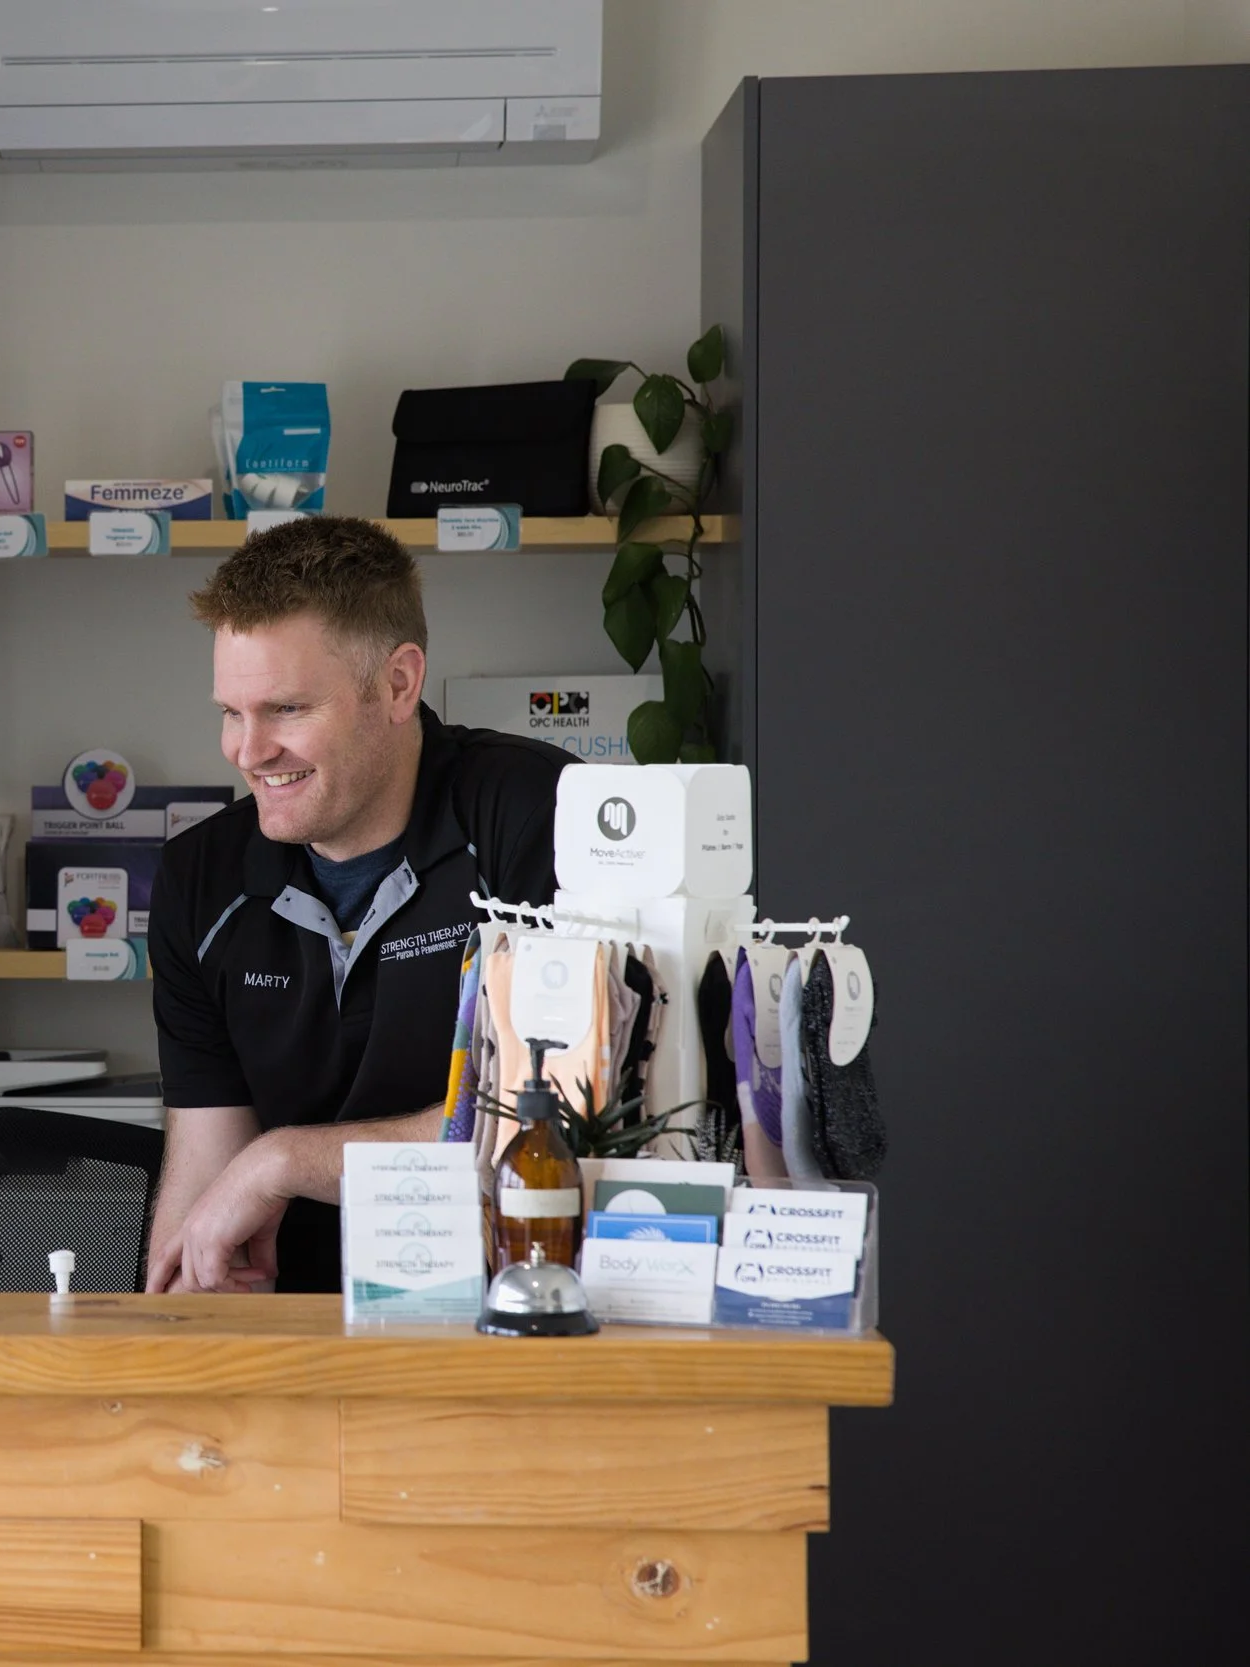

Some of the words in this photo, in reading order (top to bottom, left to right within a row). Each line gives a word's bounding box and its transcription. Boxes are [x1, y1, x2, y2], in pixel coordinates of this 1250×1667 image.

[90, 484, 184, 501] Femmeze
[430, 480, 484, 493] NeuroTrac
[529, 717, 550, 728] OPC
[553, 716, 589, 728] HEALTH
[44, 821, 77, 830] TRIGGER
[79, 821, 102, 830] POINT
[105, 821, 125, 830] BALL
[380, 933, 427, 955] STRENGTH
[427, 921, 472, 943] THERAPY
[244, 972, 290, 988] MARTY
[779, 1207, 844, 1219] CROSSFIT
[776, 1232, 841, 1245] CROSSFIT
[599, 1254, 641, 1276] Body
[767, 1265, 832, 1277] CROSSFIT
